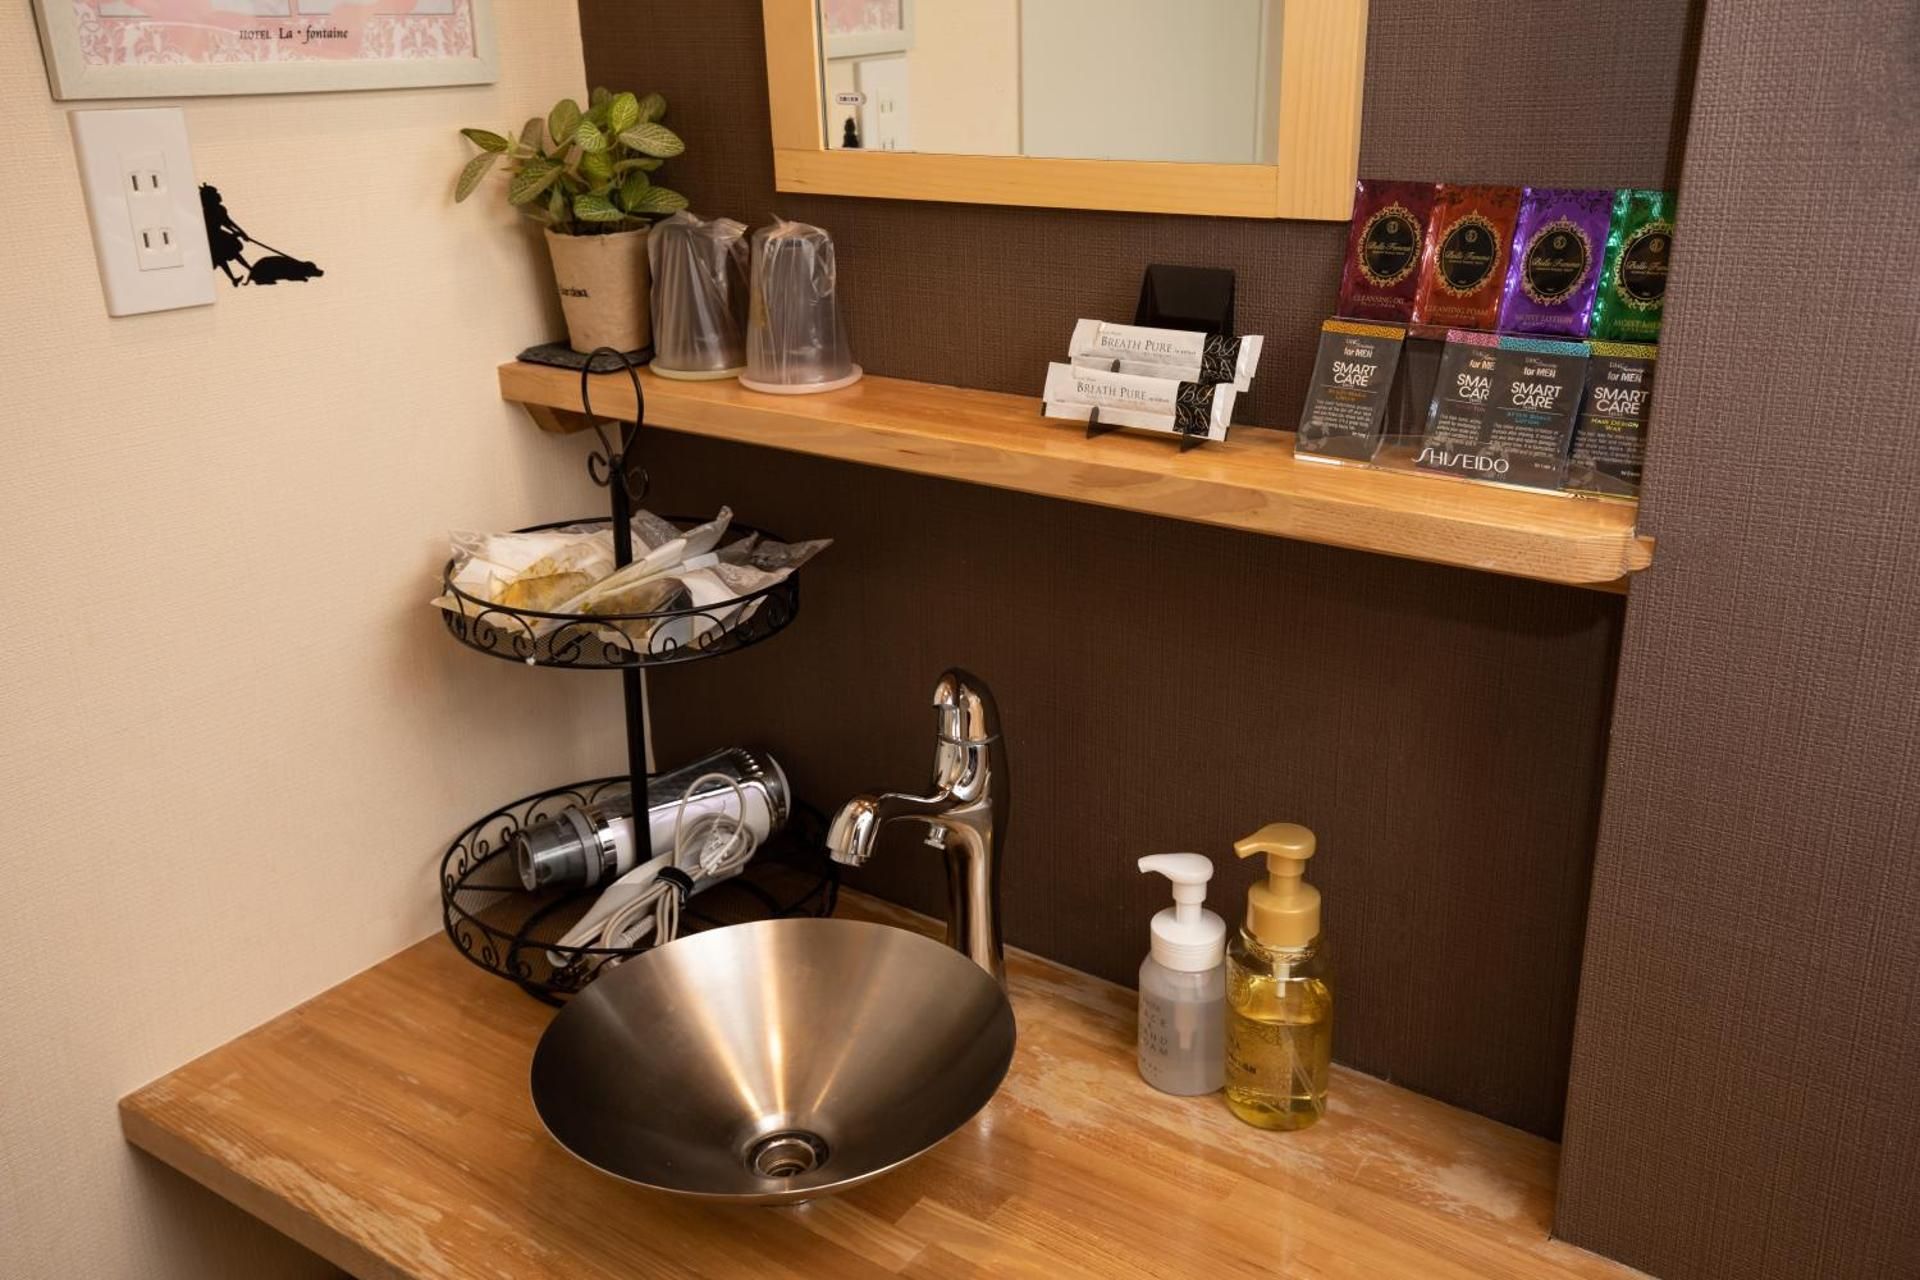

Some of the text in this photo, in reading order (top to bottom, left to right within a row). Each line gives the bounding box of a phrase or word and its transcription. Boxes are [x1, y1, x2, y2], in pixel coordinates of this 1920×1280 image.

[240, 30, 272, 40] HOTEL
[279, 27, 293, 40] La
[301, 24, 349, 45] fontaine
[1101, 335, 1141, 351] BREATH
[1145, 340, 1174, 354] PURE
[1332, 360, 1378, 377] SMART
[1481, 360, 1496, 371] ME
[1333, 373, 1369, 387] CARE
[1457, 373, 1493, 389] SMA
[1076, 381, 1117, 397] BREATH
[1120, 387, 1147, 401] PURE
[1458, 386, 1490, 400] CAR
[1511, 381, 1563, 398] SMART
[1594, 386, 1649, 403] SMART
[1512, 393, 1555, 409] CARE
[1596, 400, 1642, 415] CARE
[1411, 447, 1510, 474] SHISEIDO
